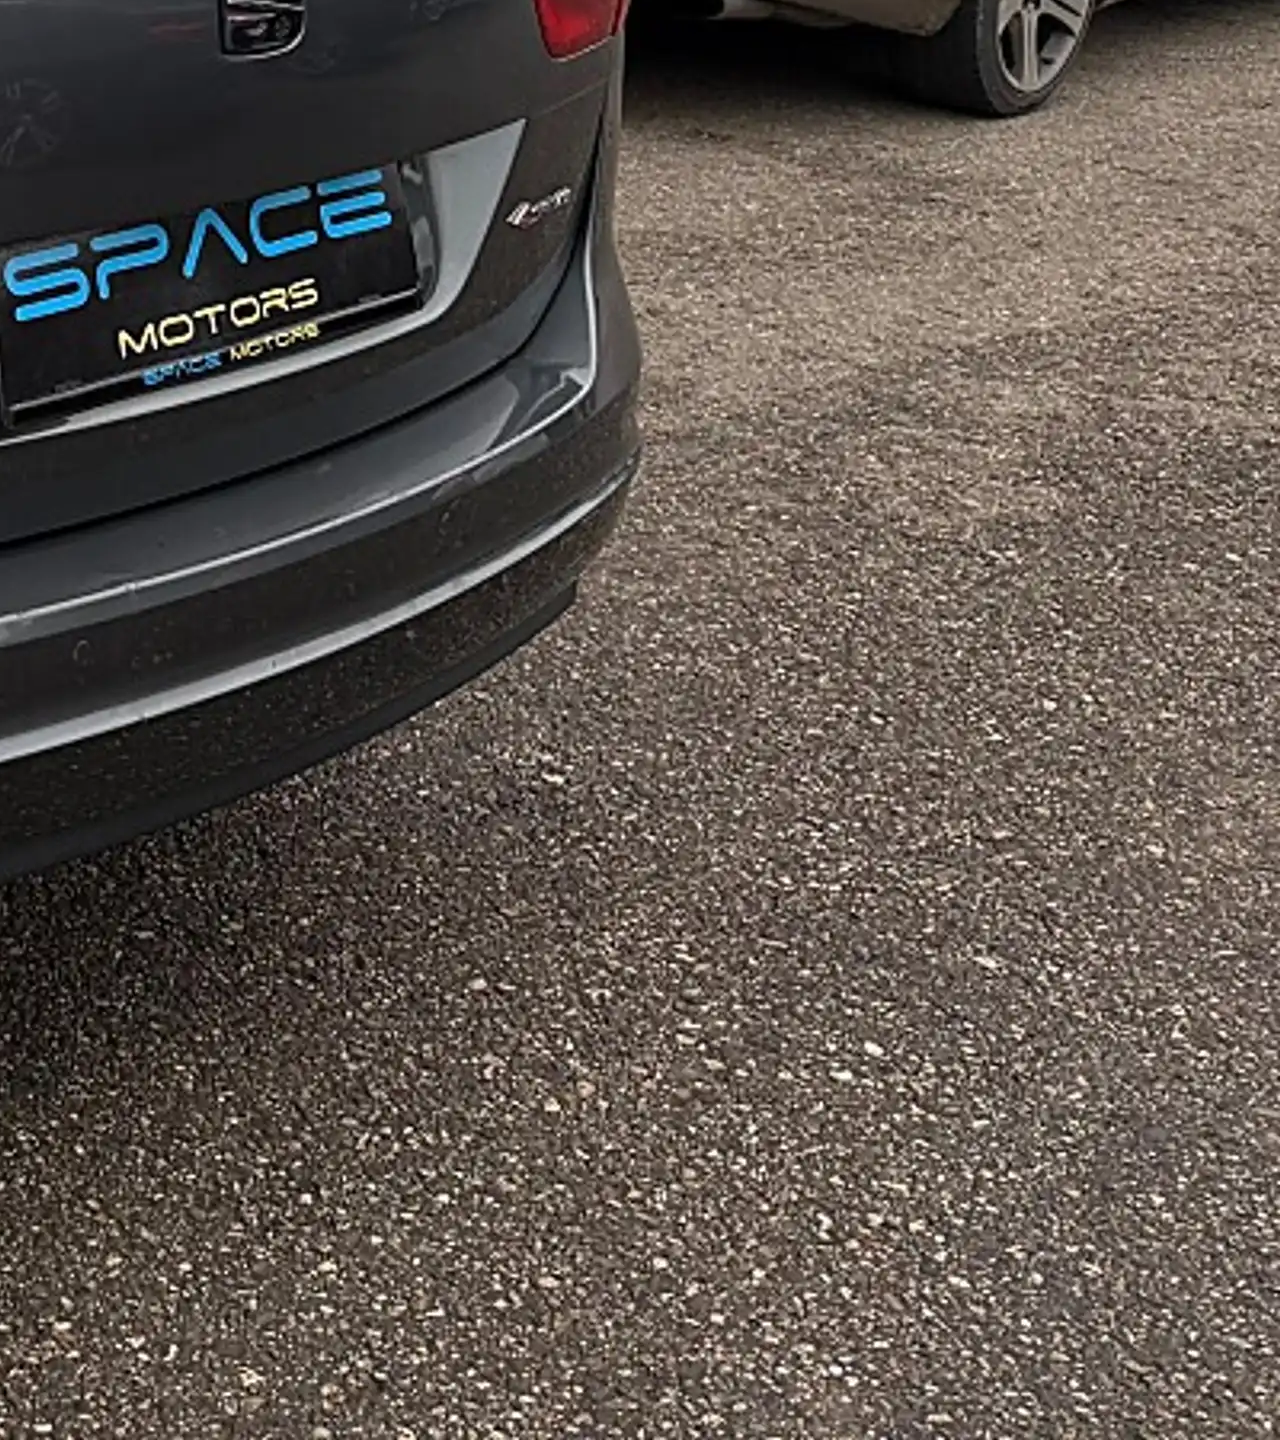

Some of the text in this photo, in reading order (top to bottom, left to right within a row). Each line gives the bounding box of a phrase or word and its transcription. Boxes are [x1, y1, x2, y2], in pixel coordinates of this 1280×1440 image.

[3, 169, 392, 321] SPACE
[118, 278, 318, 359] MOTORS
[142, 321, 321, 386] SPACE MOTORS
